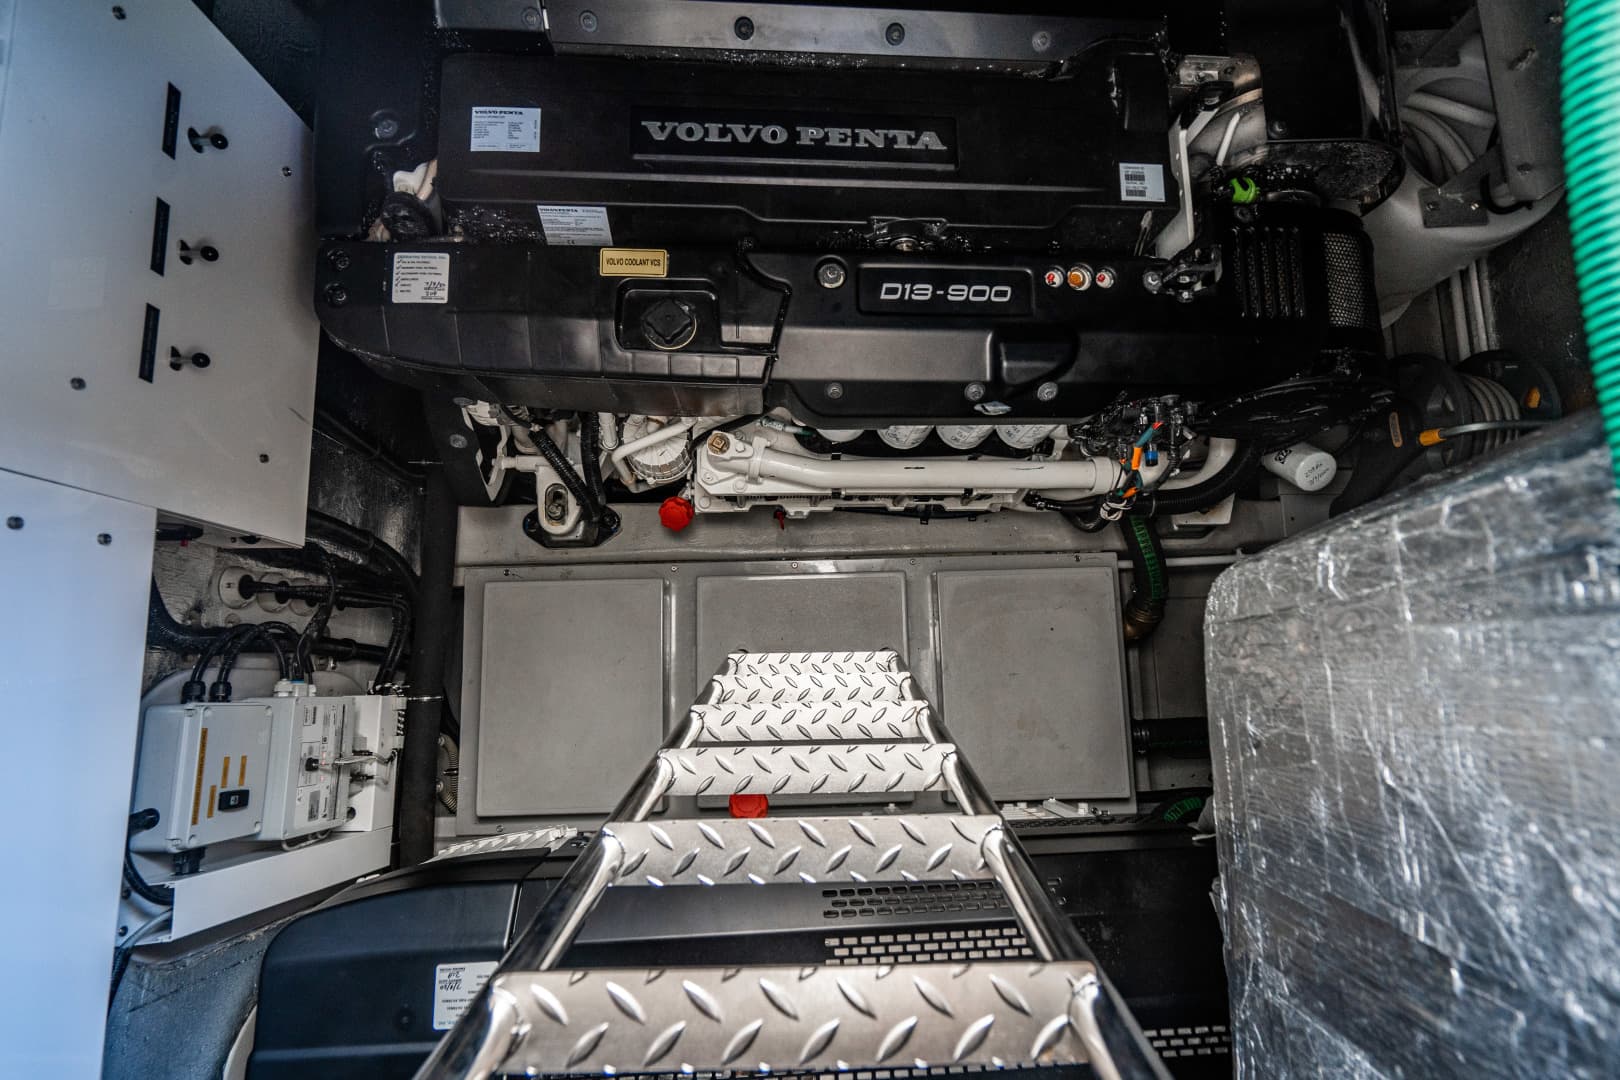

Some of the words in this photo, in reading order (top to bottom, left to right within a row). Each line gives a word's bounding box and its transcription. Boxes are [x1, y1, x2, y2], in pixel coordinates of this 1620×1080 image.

[641, 121, 788, 145] VOLVO
[795, 125, 948, 149] PENTA
[606, 257, 624, 266] VOLVO
[625, 257, 649, 266] COOLANT
[650, 258, 661, 267] VCS
[880, 282, 1012, 302] D13-900
